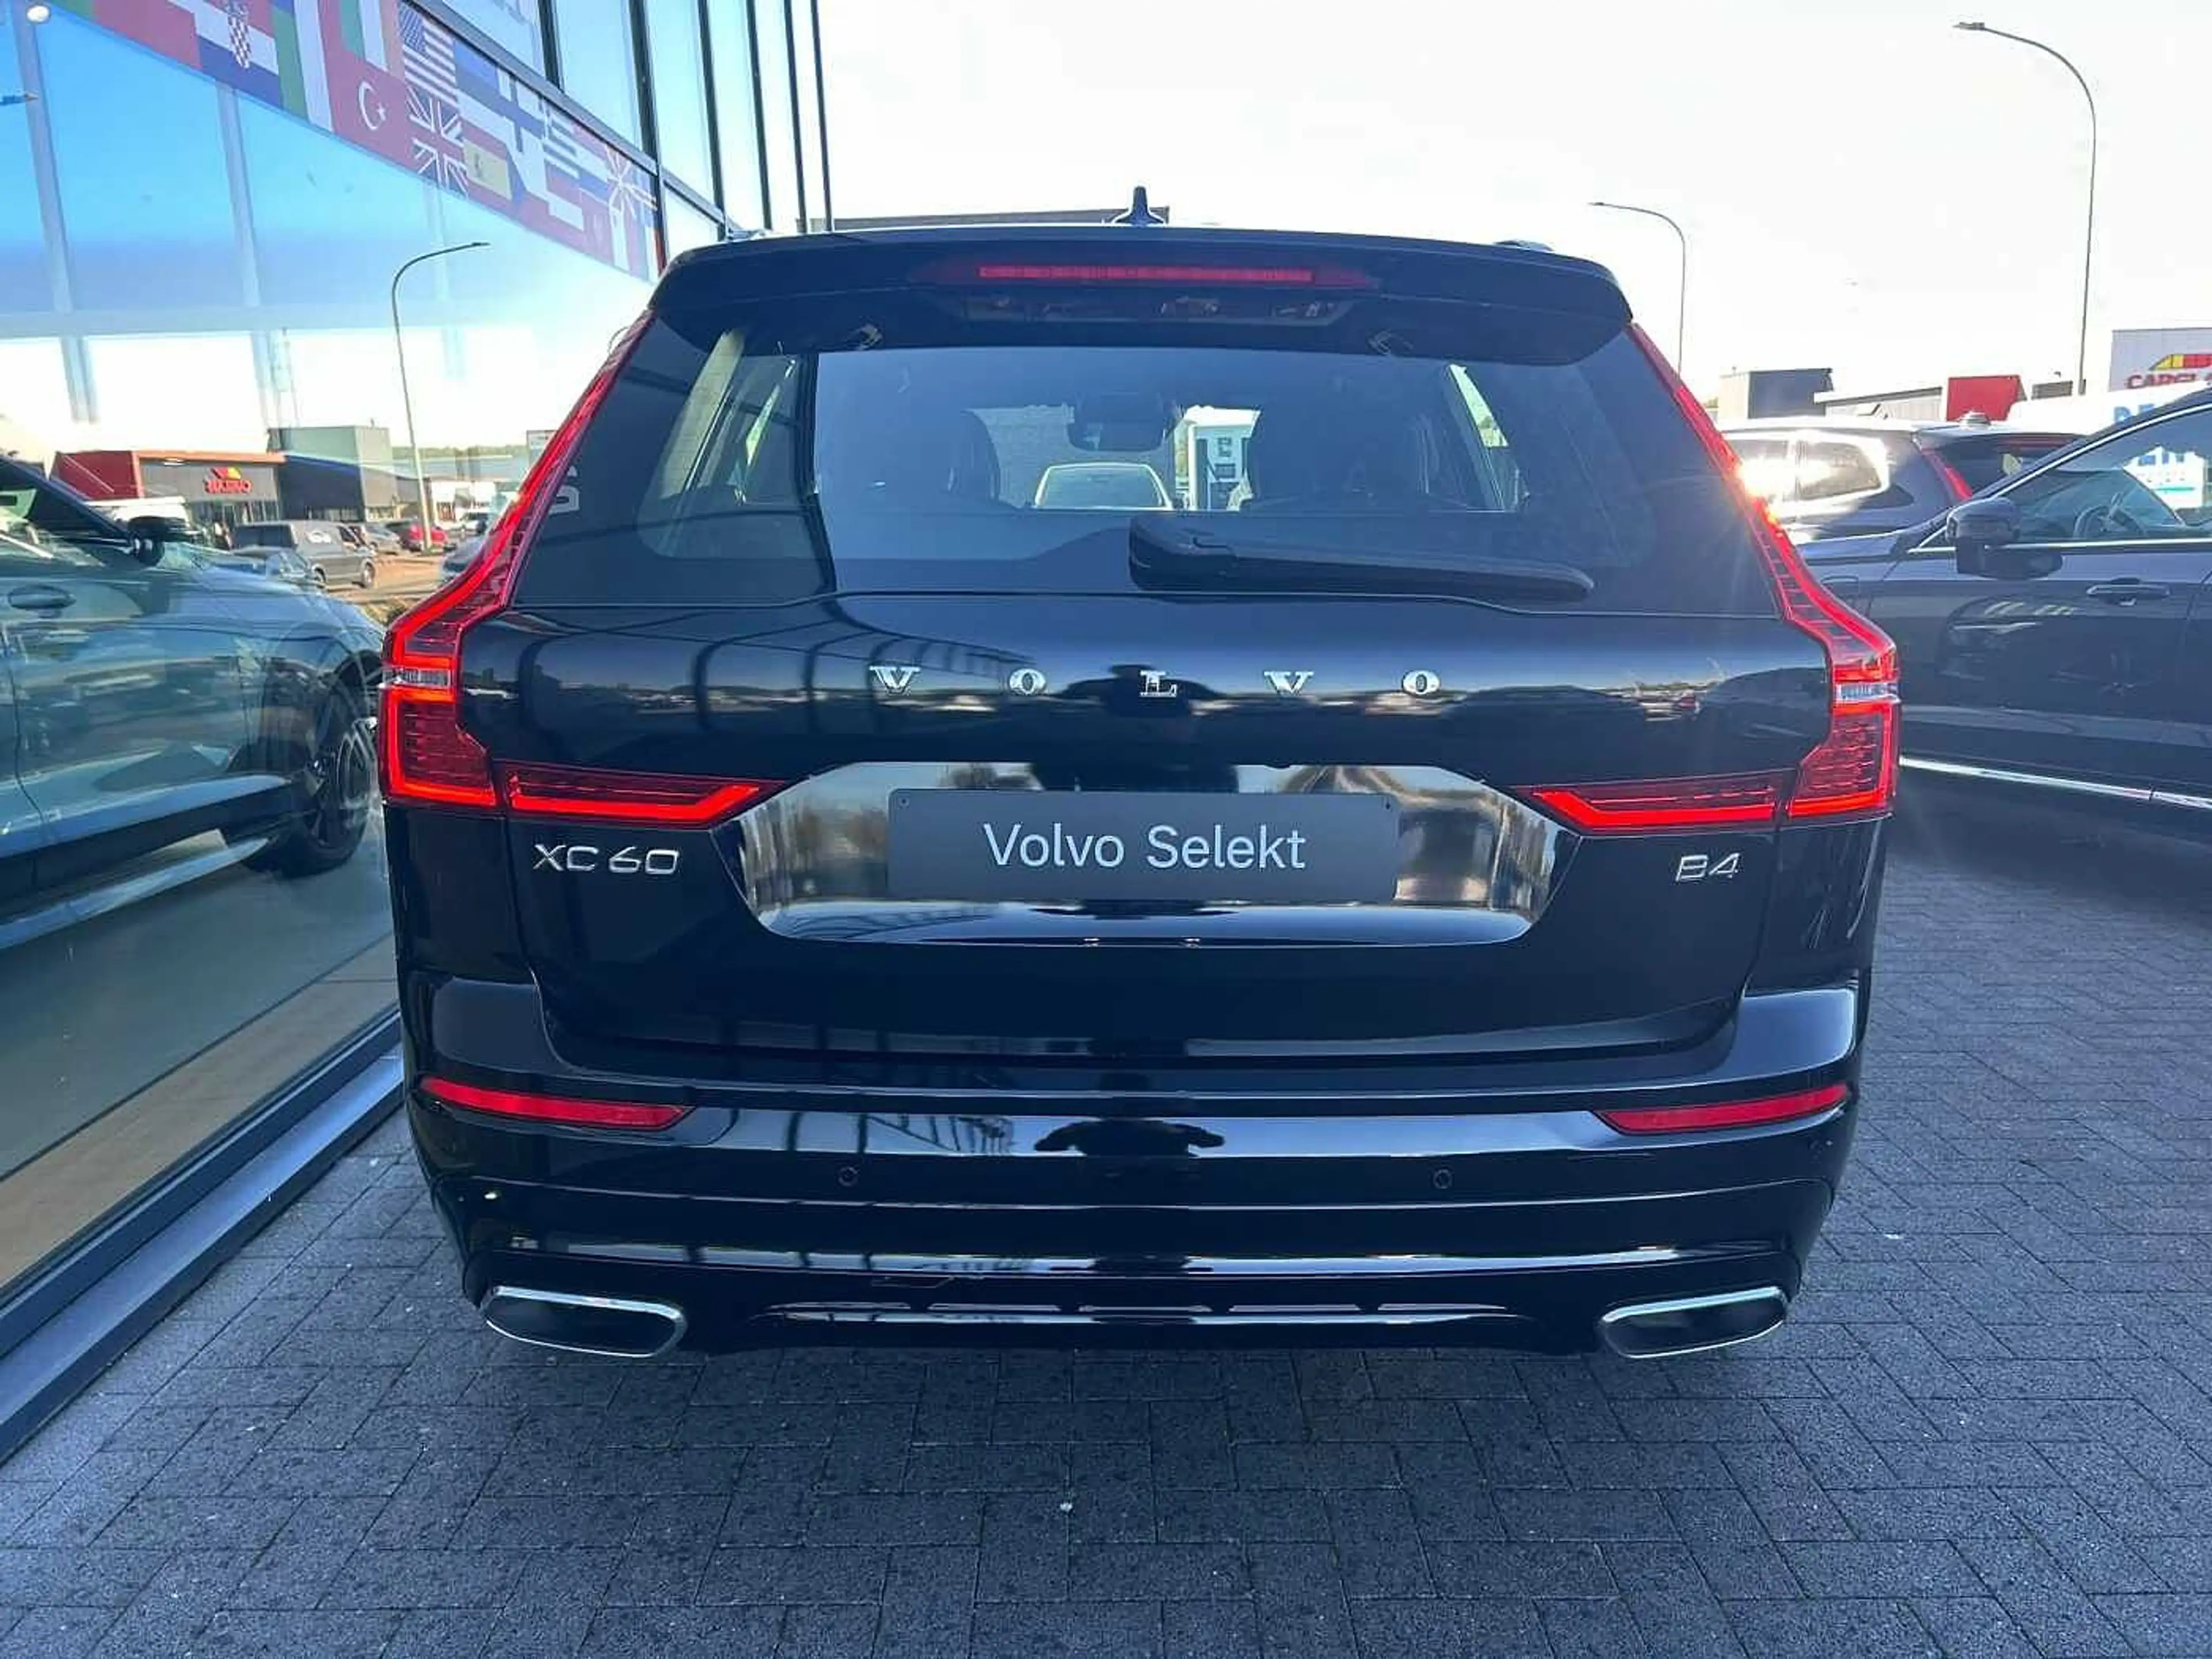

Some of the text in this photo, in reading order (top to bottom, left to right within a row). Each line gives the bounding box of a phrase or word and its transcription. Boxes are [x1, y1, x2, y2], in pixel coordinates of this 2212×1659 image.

[869, 665, 1441, 698] VOLVO
[983, 822, 1306, 868] Volvo Selekt
[1675, 853, 1740, 881] B4
